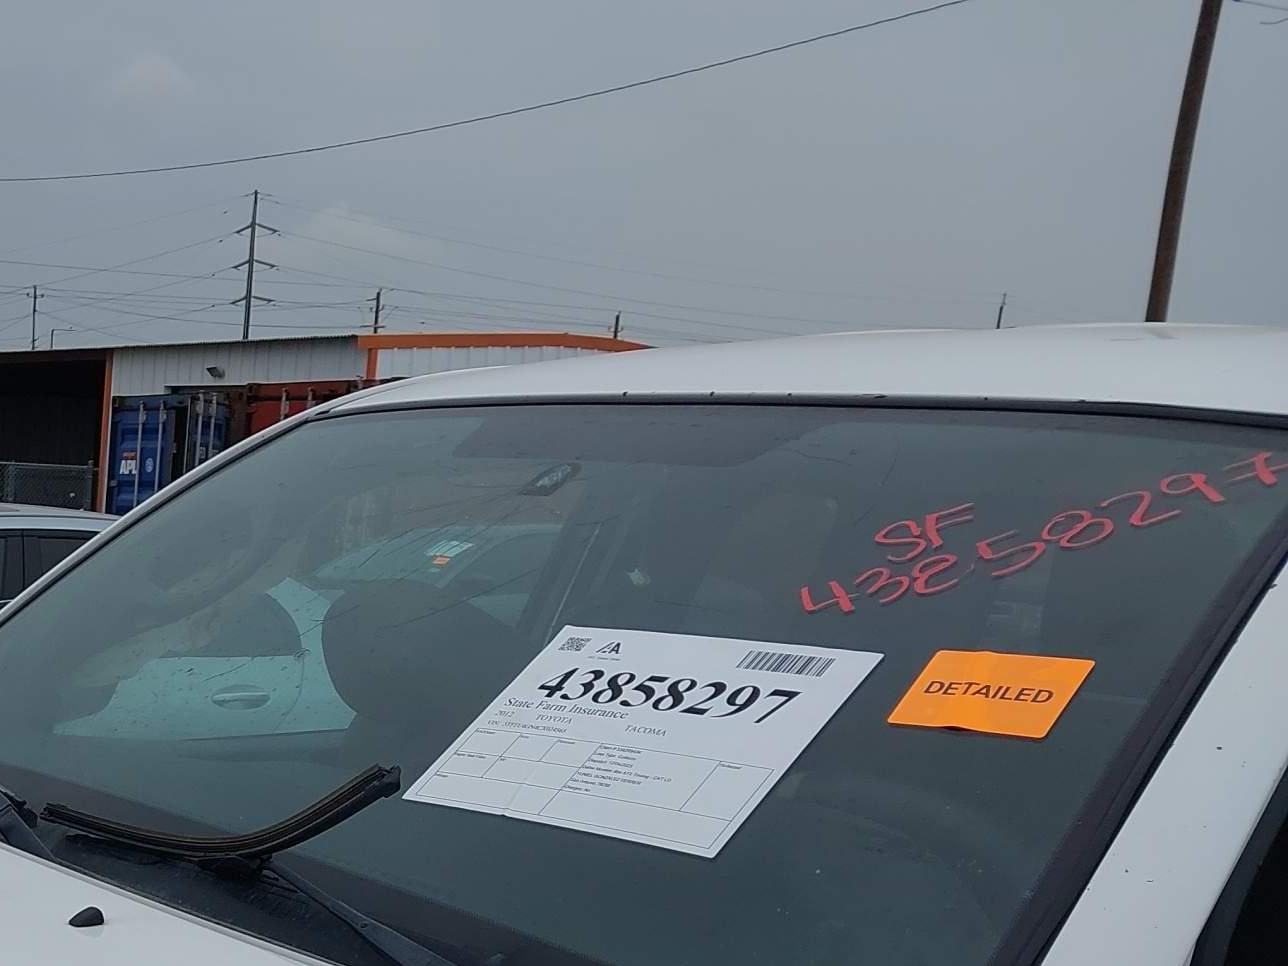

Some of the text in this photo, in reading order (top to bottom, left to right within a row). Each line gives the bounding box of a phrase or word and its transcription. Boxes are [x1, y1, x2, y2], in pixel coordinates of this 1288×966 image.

[874, 502, 974, 562] SF
[537, 667, 803, 724] 43858297
[923, 680, 1054, 705] DETAILED
[504, 697, 630, 720] State Farm Insurance
[536, 713, 573, 725] TOYOTA
[624, 724, 667, 737] TACOMA
